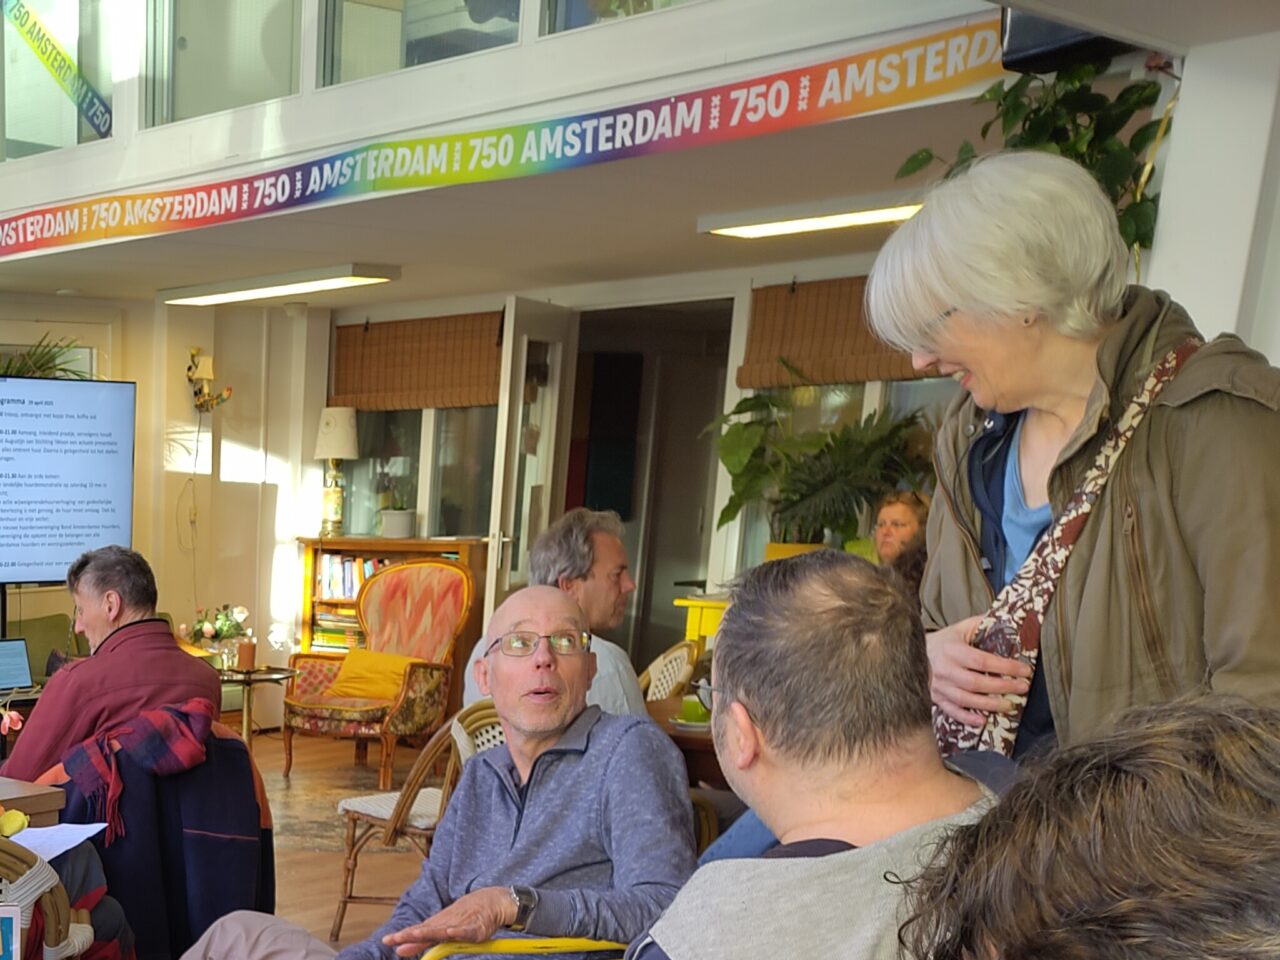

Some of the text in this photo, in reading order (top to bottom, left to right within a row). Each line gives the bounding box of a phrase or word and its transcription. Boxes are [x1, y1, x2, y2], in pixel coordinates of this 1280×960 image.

[8, 0, 111, 133] 750 AMSTERDAM 750
[91, 201, 120, 230] 750
[123, 185, 238, 226] AMSTERDAM
[252, 173, 290, 209] 750
[305, 142, 448, 196] AMSTERDAM
[468, 133, 515, 171] 750
[520, 98, 703, 164] AMSTERDAM
[729, 79, 790, 127] 750
[817, 29, 1002, 109] AMSTERD
